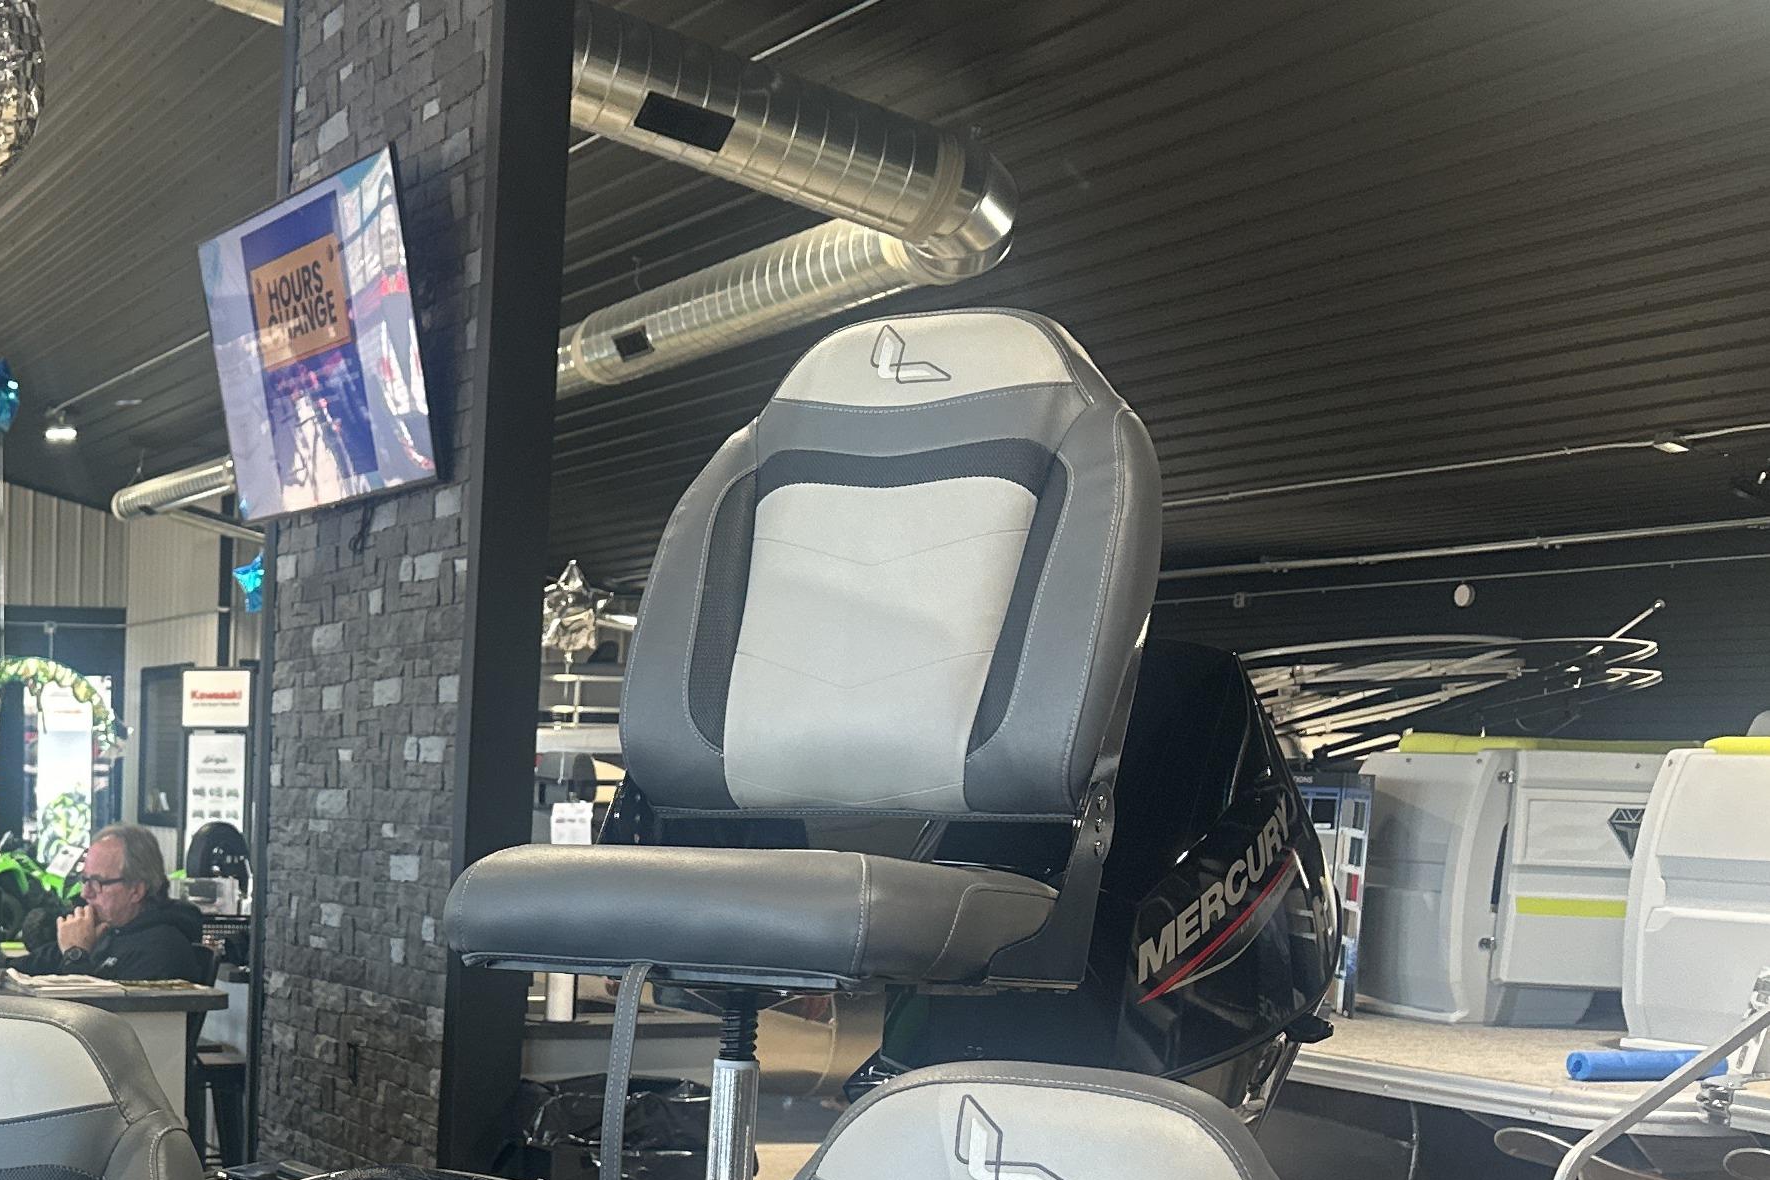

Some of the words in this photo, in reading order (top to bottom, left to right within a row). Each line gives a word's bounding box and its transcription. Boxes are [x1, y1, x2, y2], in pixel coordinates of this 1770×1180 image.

[267, 260, 324, 313] HOURS
[191, 689, 242, 700] Kawasaki
[1138, 791, 1290, 985] MERCURY
